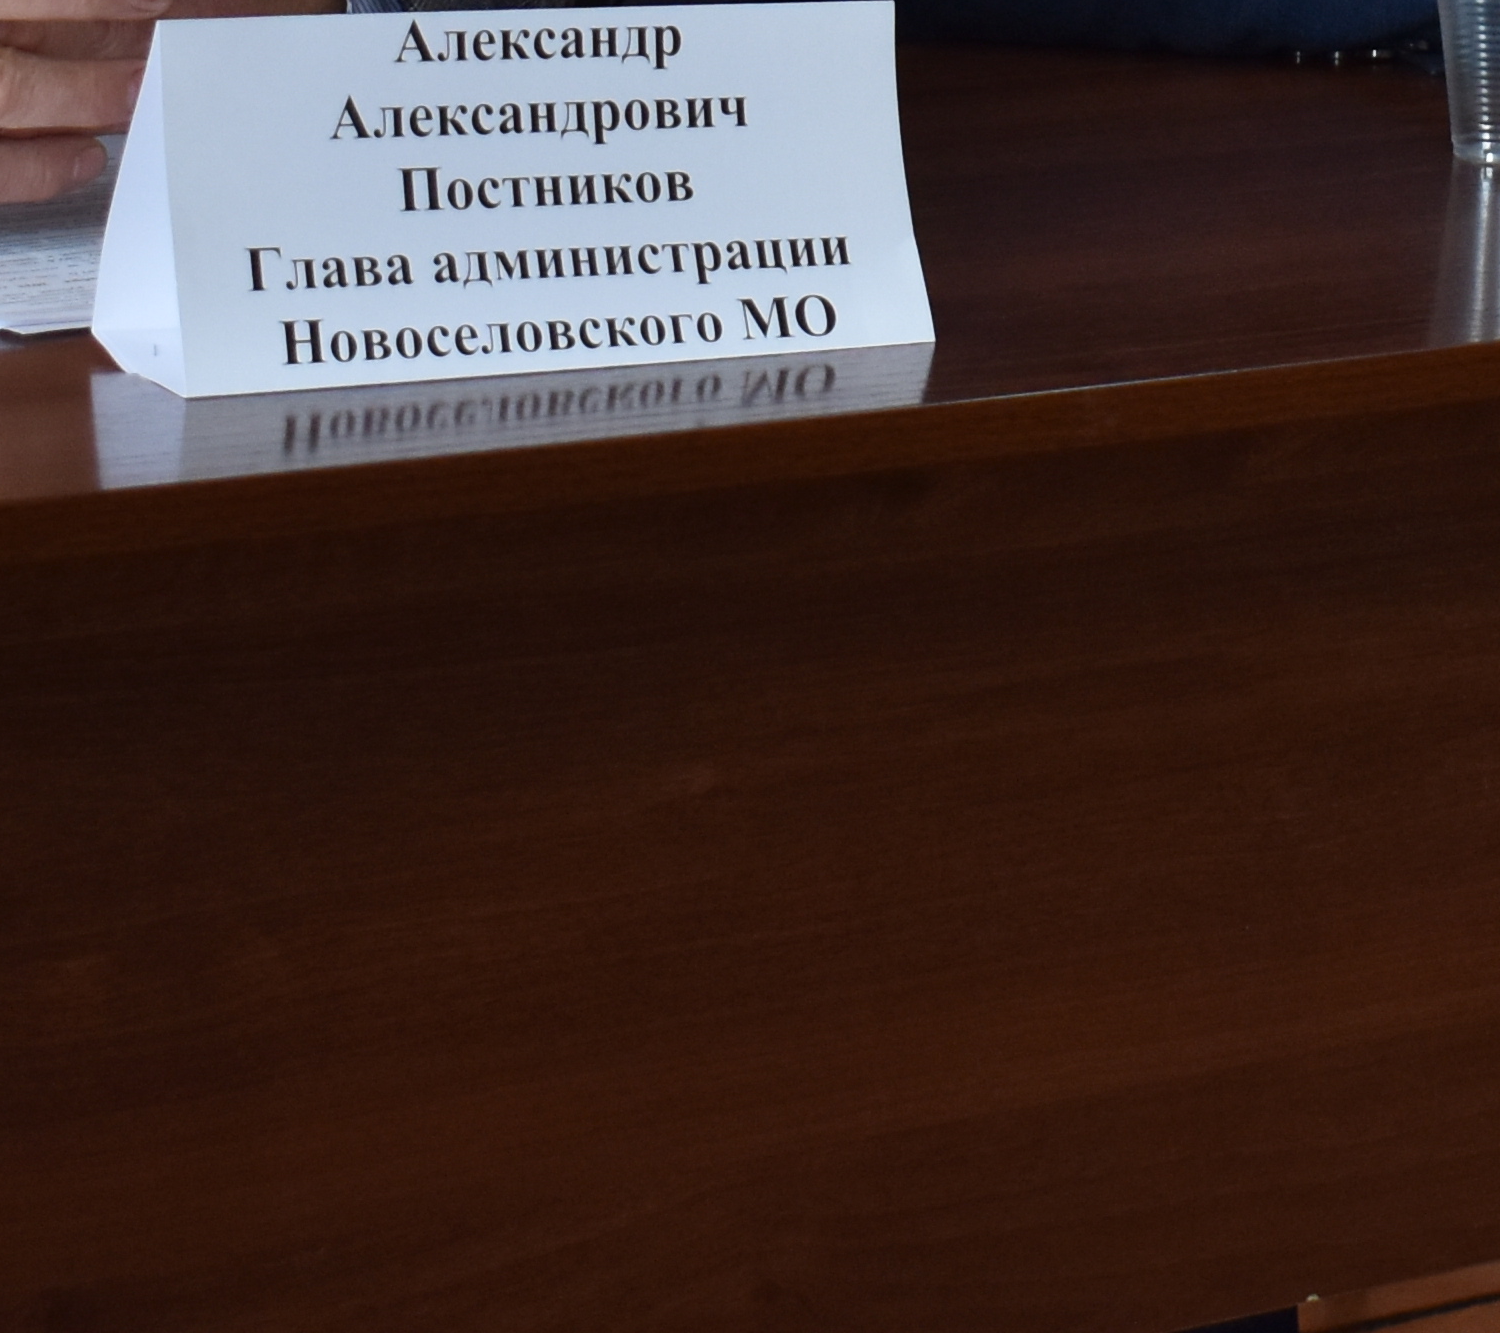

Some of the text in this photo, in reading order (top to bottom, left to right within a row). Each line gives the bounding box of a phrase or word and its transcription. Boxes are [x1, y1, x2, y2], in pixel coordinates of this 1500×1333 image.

[394, 18, 684, 70] Александр
[330, 94, 750, 145] Александрович
[399, 167, 695, 214] Постников
[246, 233, 852, 293] Глава администрации
[282, 294, 837, 367] Новоселовского МО
